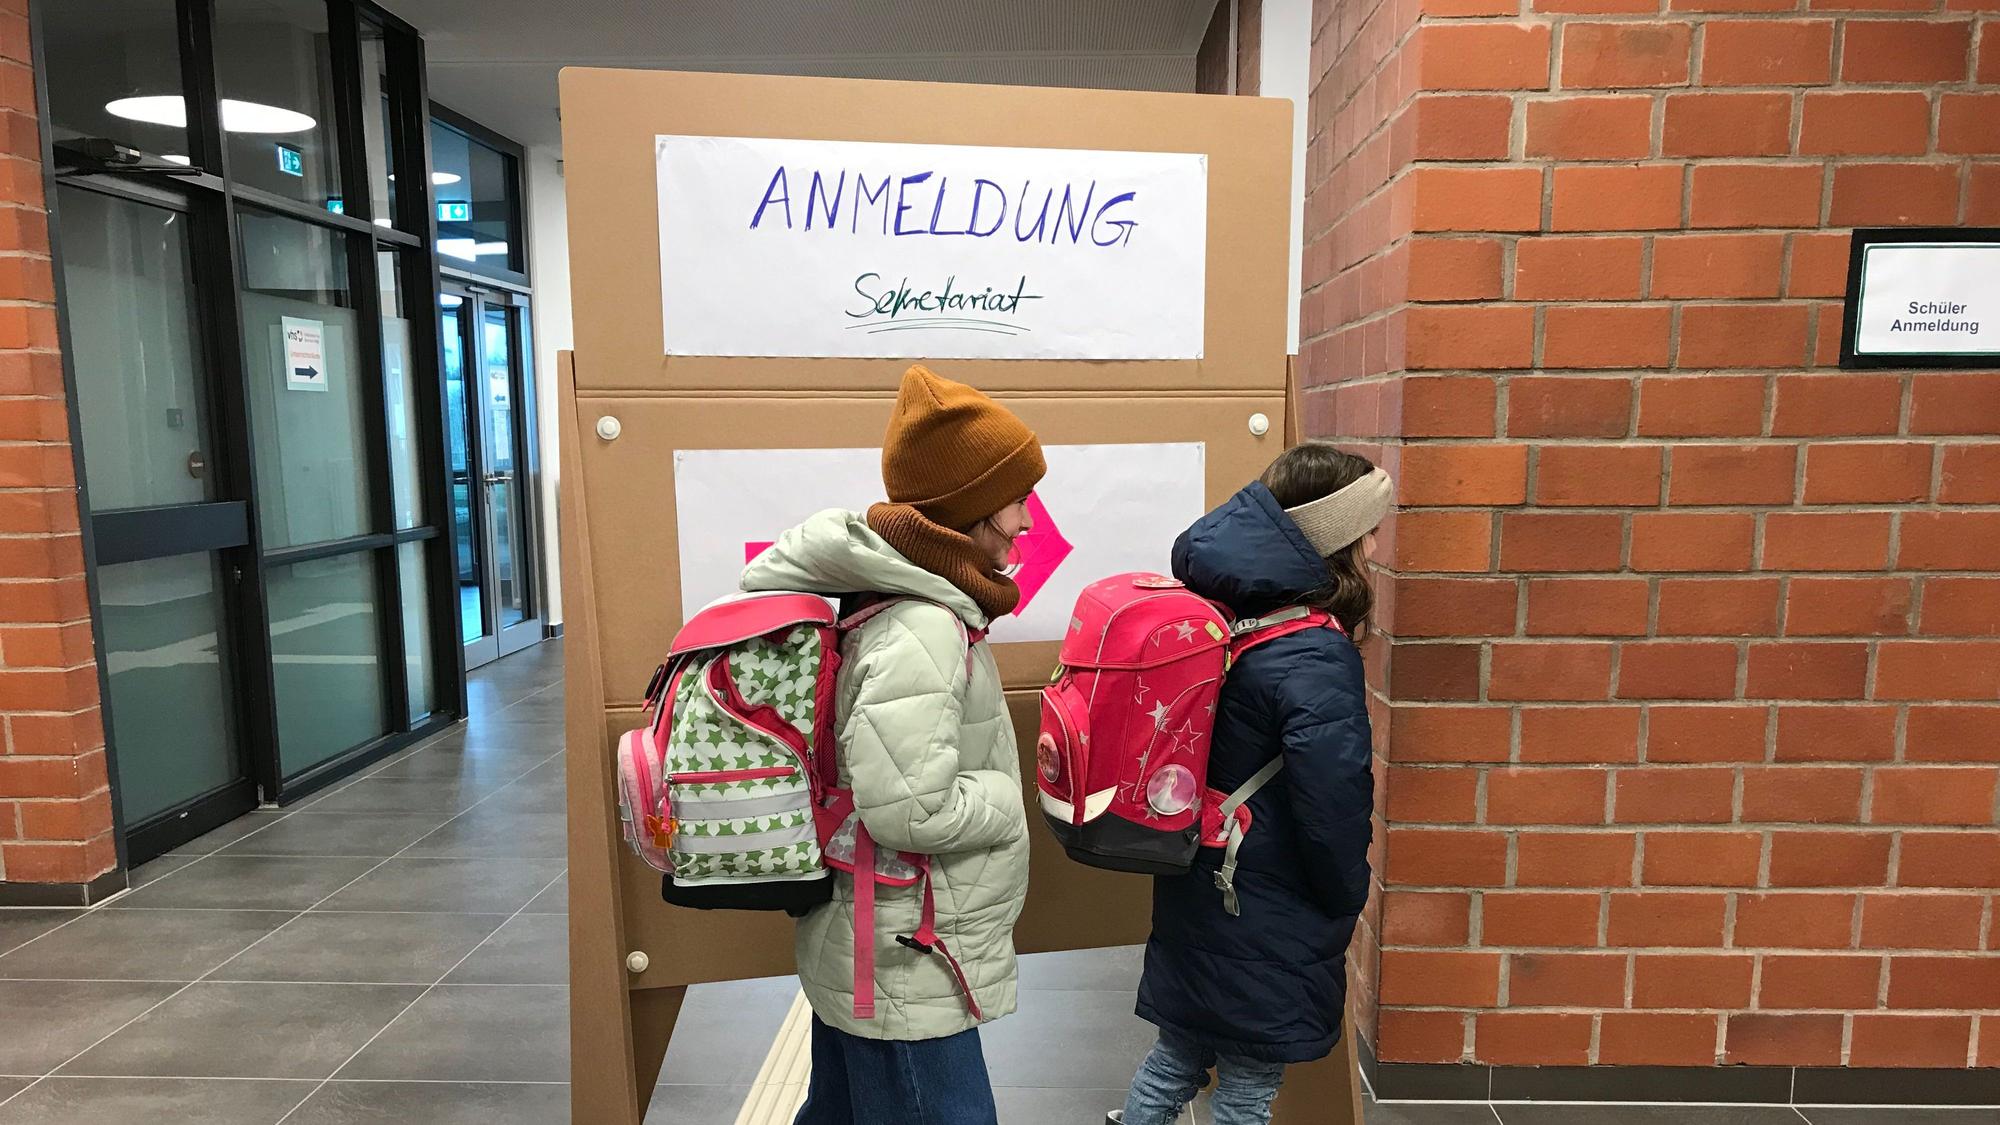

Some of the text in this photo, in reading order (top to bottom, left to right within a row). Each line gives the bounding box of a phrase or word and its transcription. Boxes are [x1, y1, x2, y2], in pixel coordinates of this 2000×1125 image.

[750, 166, 1139, 247] ANMELDUNG
[845, 272, 1043, 318] Sekretariat
[1908, 301, 1968, 315] Schüler
[1890, 318, 1980, 335] Anmeldung
